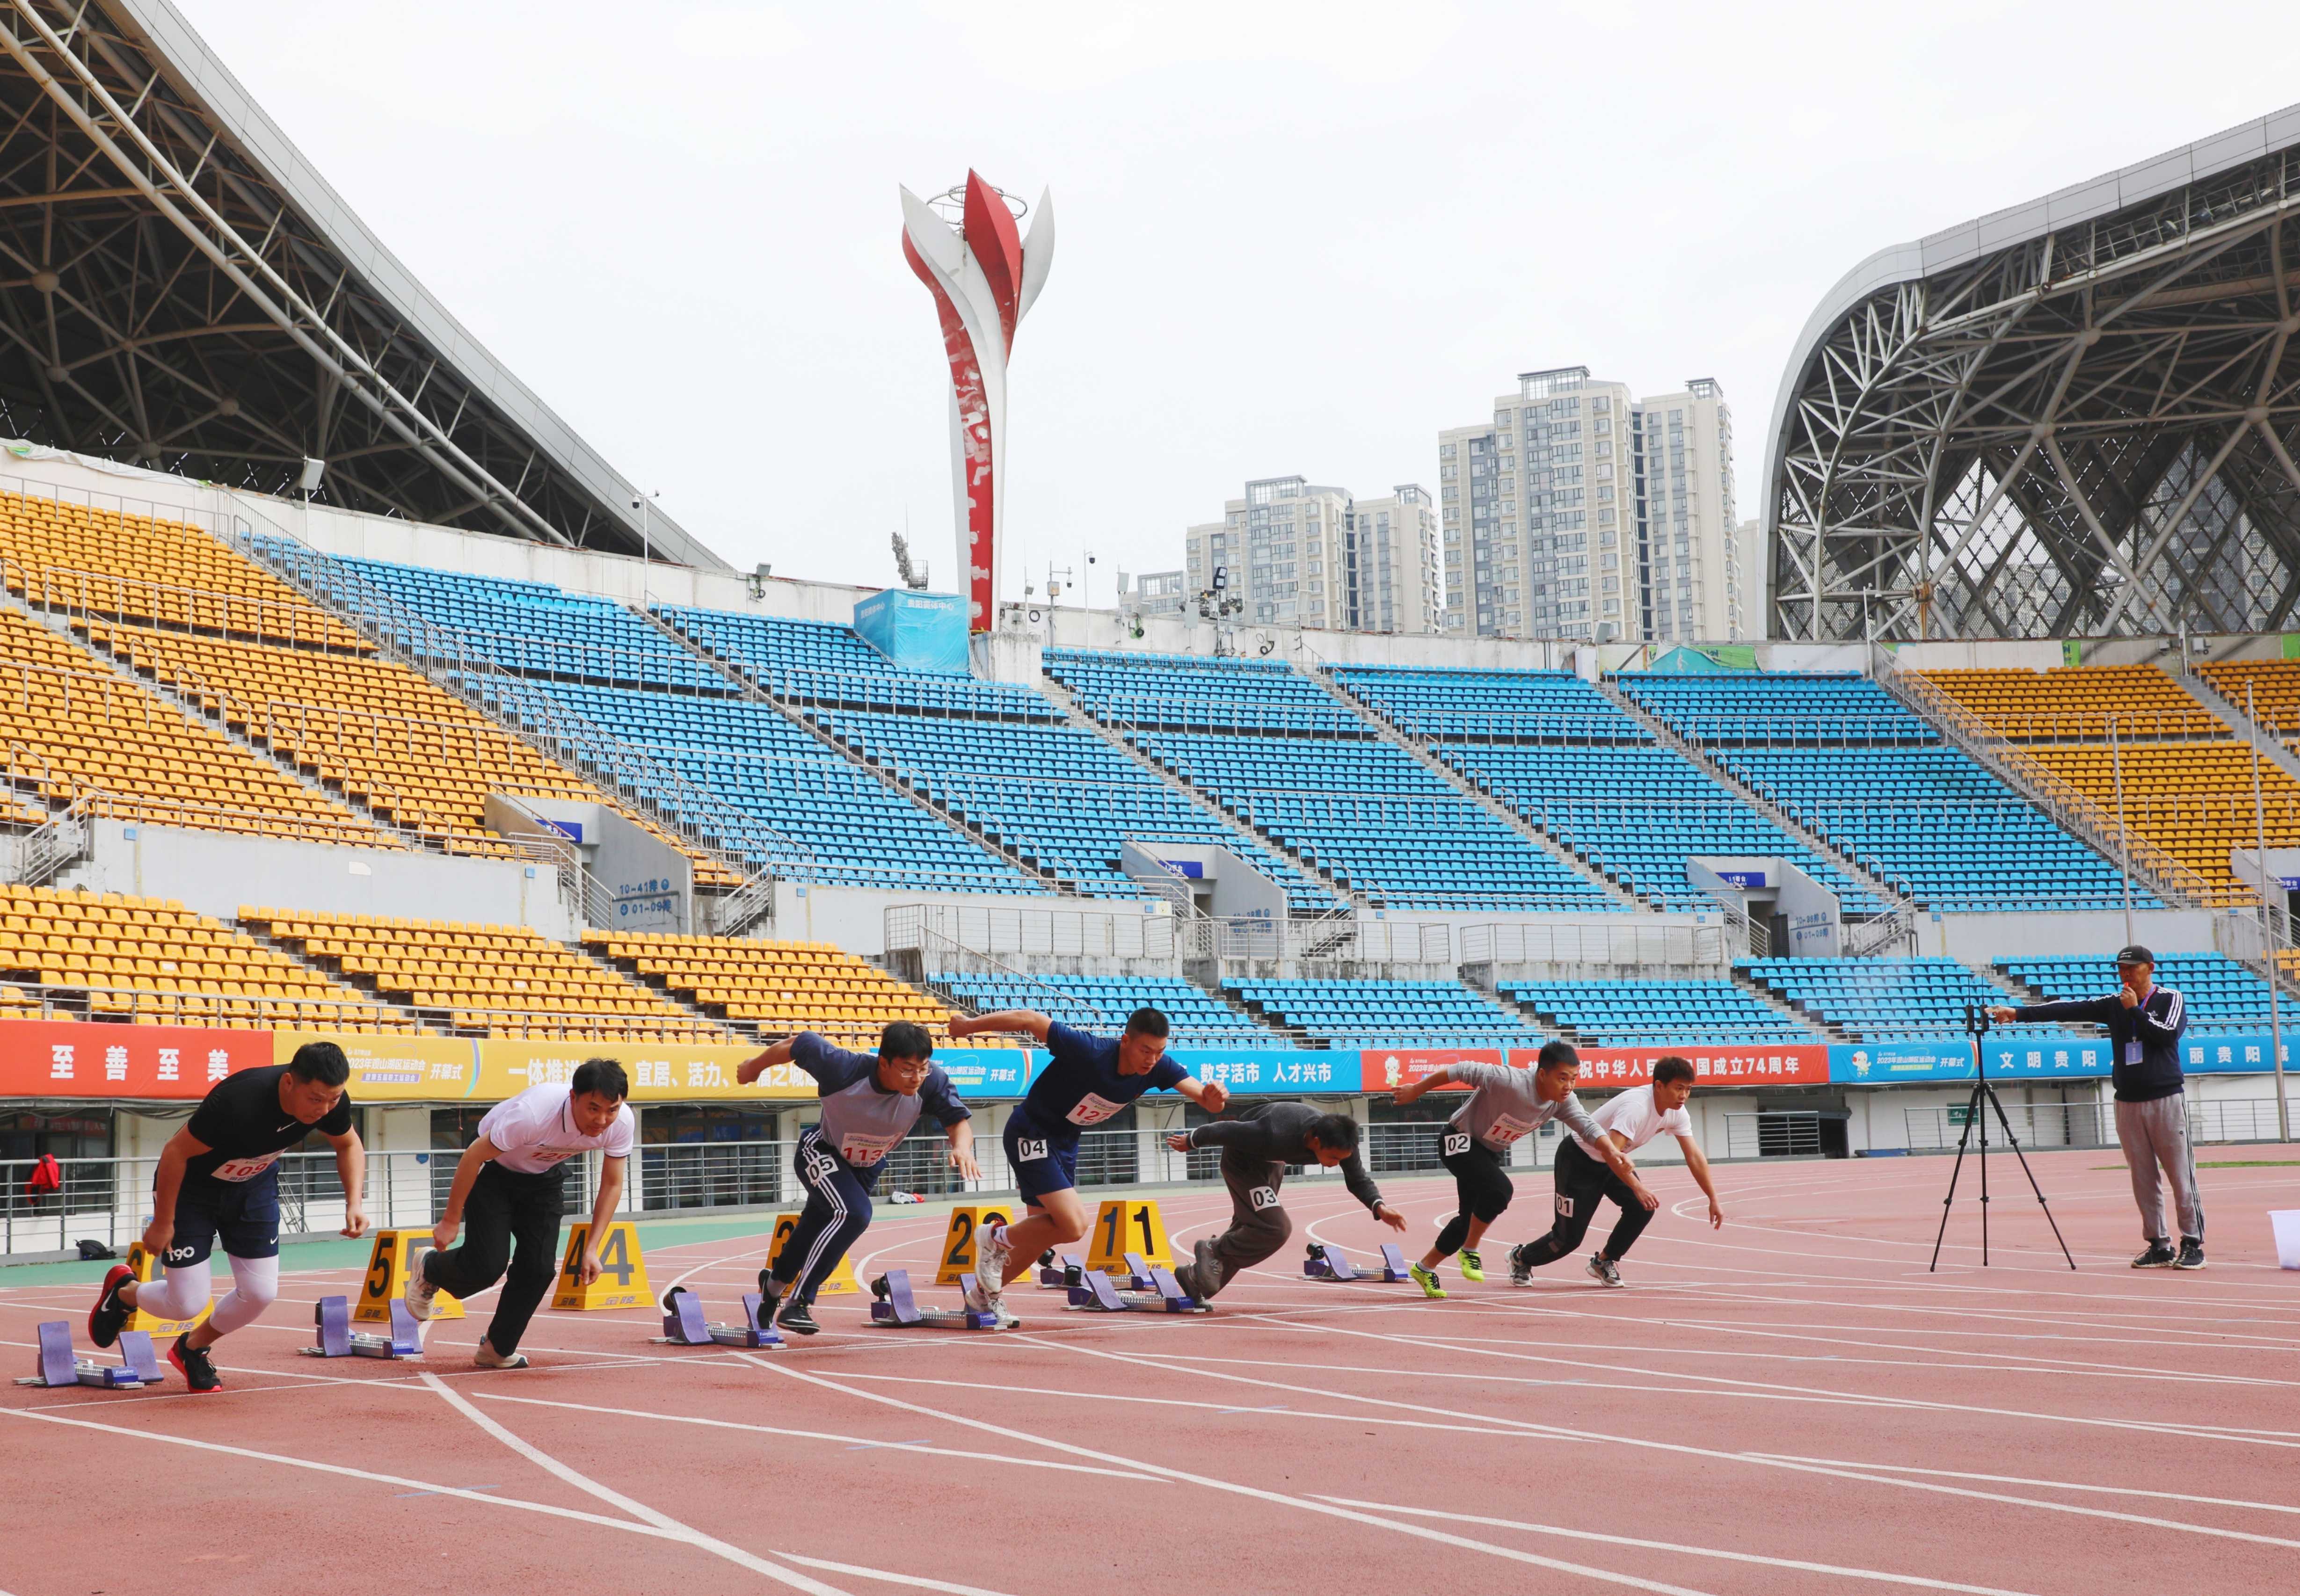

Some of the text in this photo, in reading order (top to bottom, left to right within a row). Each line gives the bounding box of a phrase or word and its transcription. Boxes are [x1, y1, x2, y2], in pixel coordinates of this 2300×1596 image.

[1940, 1058, 1965, 1067] 开幕式
[2000, 1050, 2113, 1069] 文明贵阳
[430, 1064, 463, 1080] 开幕式
[990, 1069, 1016, 1081] 开幕式
[1200, 1062, 1331, 1084] 数字活市 人才兴市
[1020, 1140, 1045, 1157] 04
[1448, 1136, 1468, 1151] 02
[809, 1156, 833, 1180] 05
[1253, 1189, 1276, 1206] 03
[1558, 1197, 1570, 1213] 01
[946, 1213, 972, 1265] 2
[1104, 1207, 1118, 1256] 1
[1134, 1206, 1154, 1255] 1
[565, 1229, 586, 1287] 4
[599, 1229, 634, 1285] 4
[369, 1238, 393, 1298] 5
